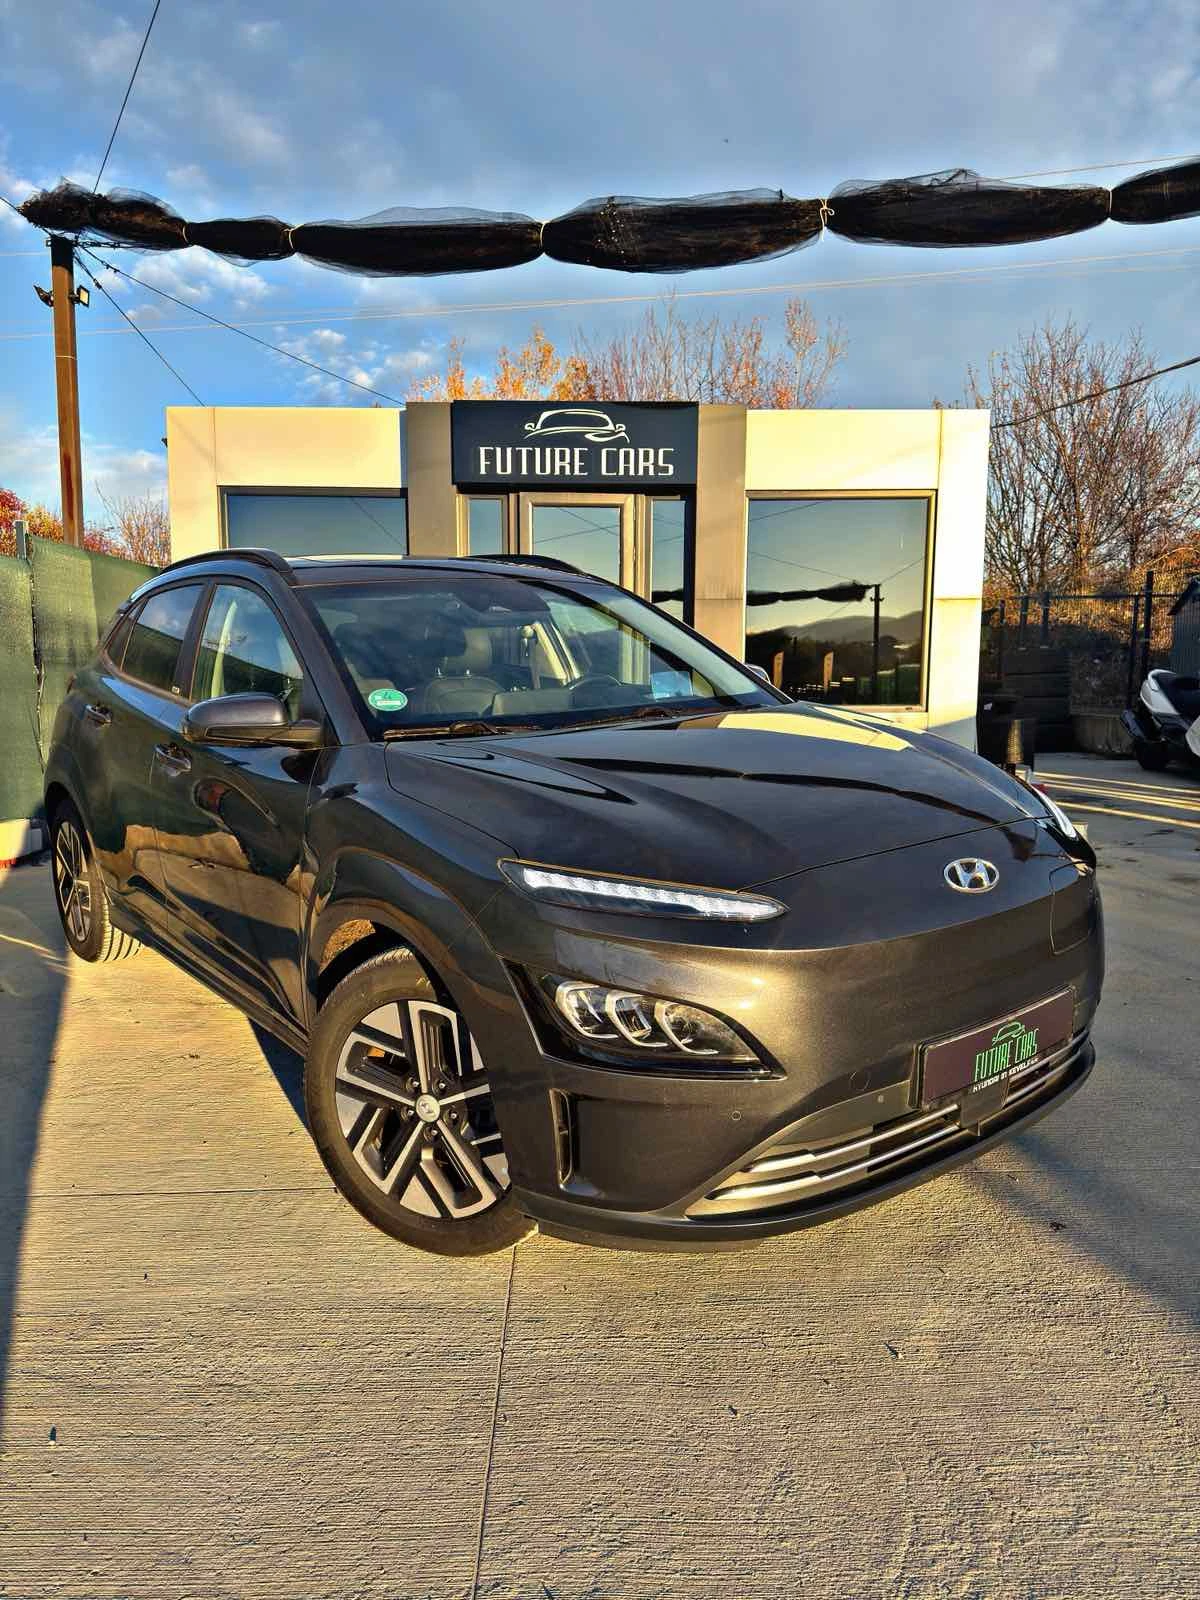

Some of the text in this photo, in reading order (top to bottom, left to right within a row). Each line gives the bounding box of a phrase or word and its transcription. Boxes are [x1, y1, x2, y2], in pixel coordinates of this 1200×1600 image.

[479, 447, 675, 476] FUTURE CARS
[974, 1040, 1014, 1083] FUTURE
[1015, 1028, 1040, 1063] CARS
